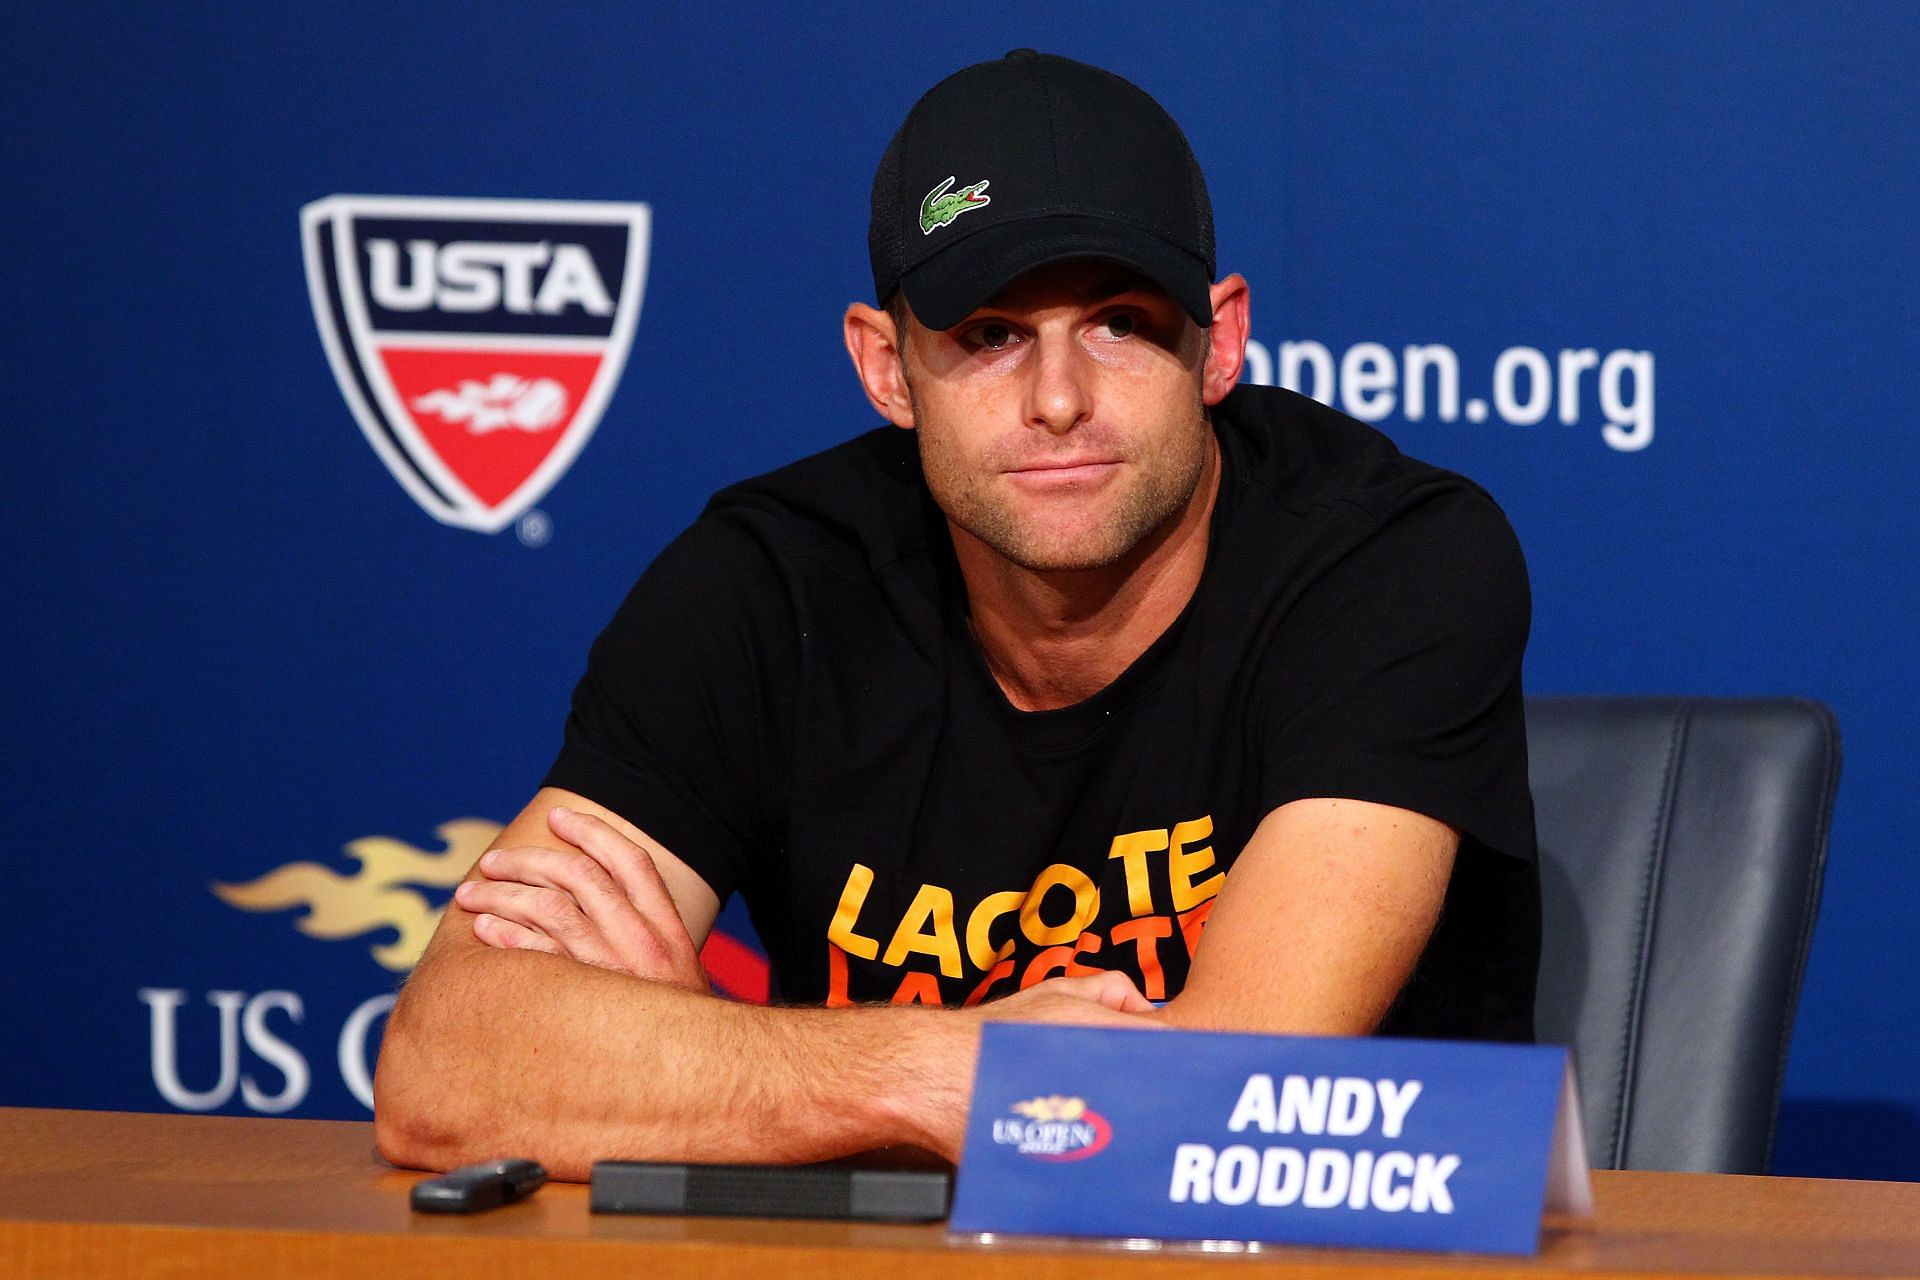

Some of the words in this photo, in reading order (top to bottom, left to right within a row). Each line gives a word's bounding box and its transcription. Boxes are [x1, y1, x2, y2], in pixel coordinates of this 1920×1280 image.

[366, 238, 613, 316] USTA
[138, 987, 311, 1114] US
[1228, 1074, 1422, 1138] ANDY
[1169, 1144, 1461, 1214] RODDICK
